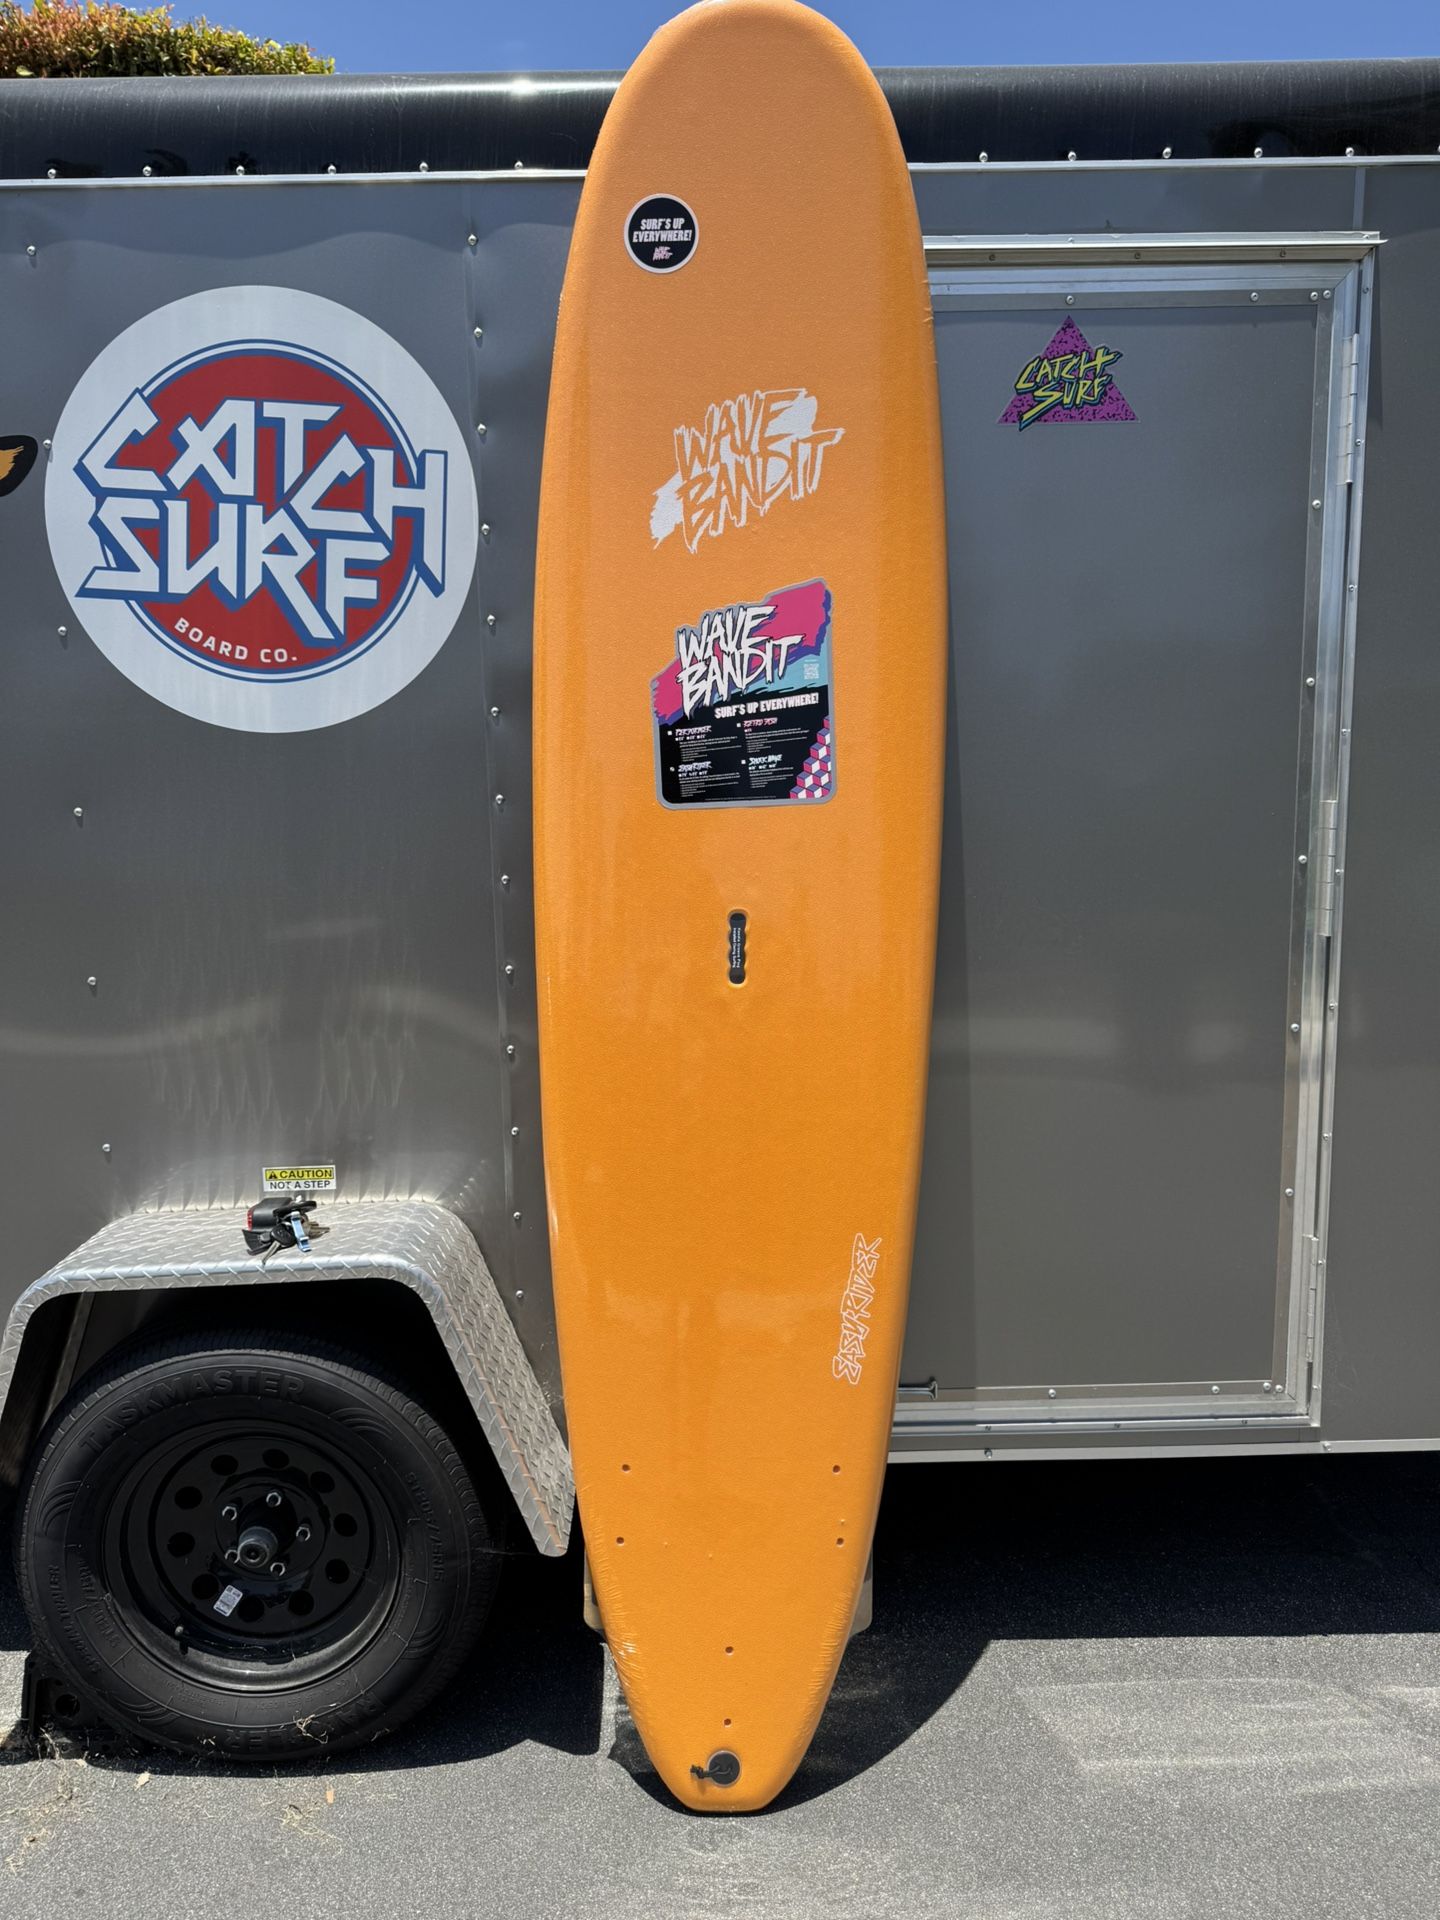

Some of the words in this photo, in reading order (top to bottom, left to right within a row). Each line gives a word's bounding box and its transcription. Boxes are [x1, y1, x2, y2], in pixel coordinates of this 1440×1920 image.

[632, 229, 692, 243] EVERYWHERE!
[640, 218, 671, 230] SURF'S
[672, 217, 685, 229] UP
[1014, 346, 1123, 394] CATCH
[1019, 373, 1113, 432] SURF
[674, 388, 807, 481] WAVE
[74, 388, 448, 597] CATCH
[675, 429, 846, 554] BANDIT
[75, 496, 391, 647] SURF
[174, 617, 249, 661] BOARD
[259, 648, 299, 664] CO.
[677, 604, 778, 668] WAVE
[677, 634, 806, 720] BANDIT
[714, 704, 746, 719] SURF'S
[747, 701, 760, 715] UP
[760, 693, 819, 713] EVERYWHERE!
[270, 1181, 291, 1189] NOT
[294, 1181, 301, 1189] A
[303, 1180, 330, 1188] STEP
[280, 1169, 332, 1179] CAUTION
[80, 1369, 306, 1454] TASKMASTER
